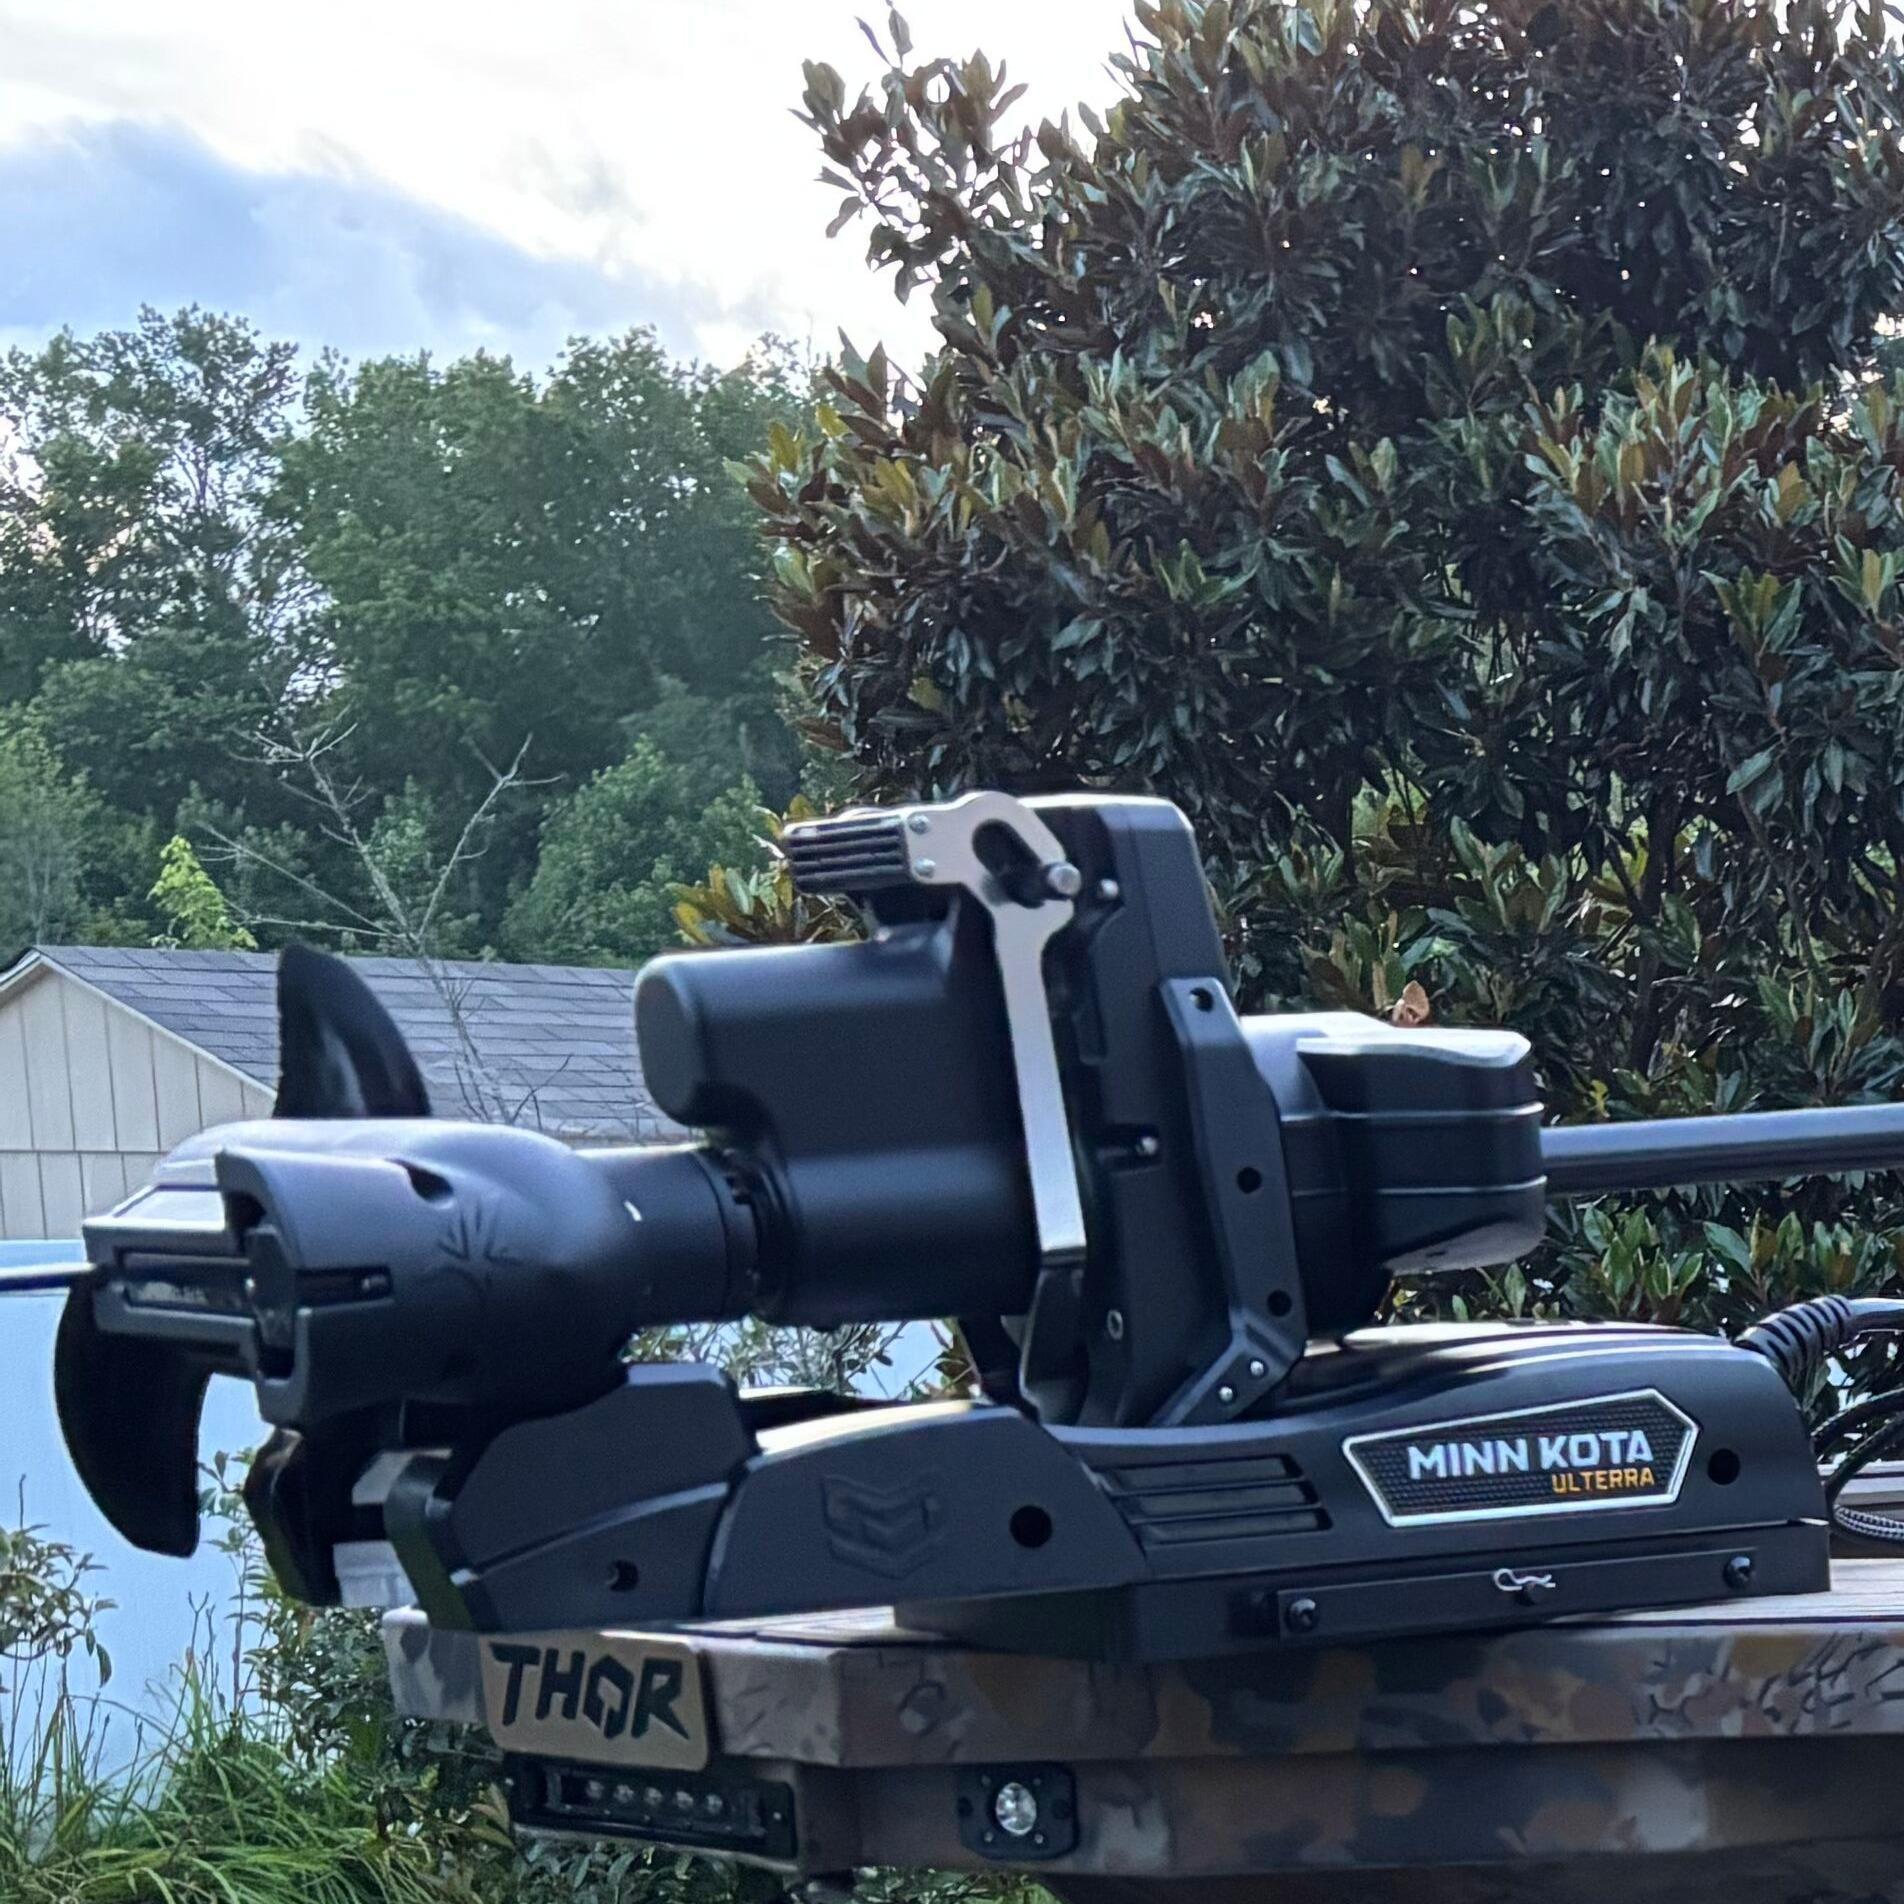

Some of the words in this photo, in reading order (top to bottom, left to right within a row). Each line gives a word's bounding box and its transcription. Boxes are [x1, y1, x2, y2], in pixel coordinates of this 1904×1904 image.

[1407, 1438, 1529, 1480] MINN
[1538, 1430, 1653, 1470] KOTA
[1551, 1467, 1655, 1493] ULTERRA
[488, 1642, 690, 1739] THOR
